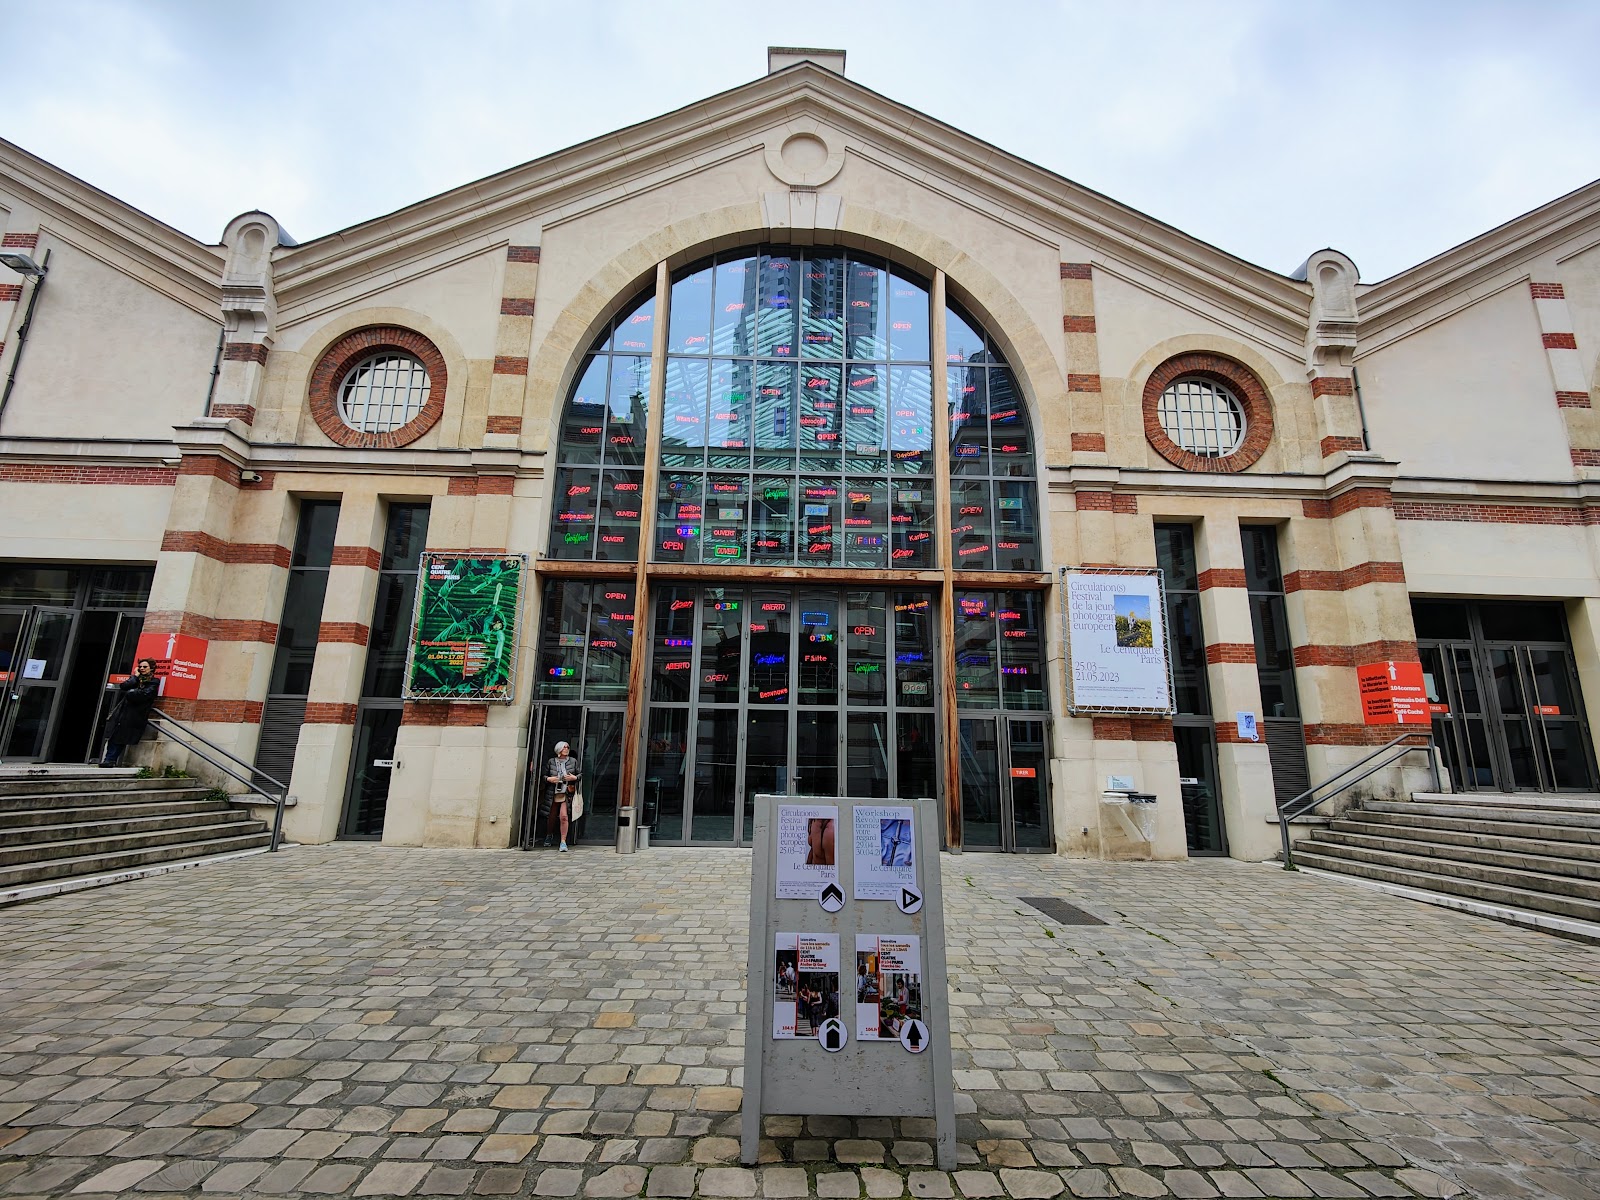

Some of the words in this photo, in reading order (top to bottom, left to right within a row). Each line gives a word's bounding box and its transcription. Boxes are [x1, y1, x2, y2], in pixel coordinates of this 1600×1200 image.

[686, 336, 704, 344] Open
[807, 378, 828, 388] Open
[568, 486, 590, 495] Open
[676, 526, 700, 535] OPEN
[662, 541, 684, 549] OPEN
[809, 543, 831, 553] Open
[892, 548, 914, 558] Open
[1071, 582, 1126, 593] Circulation(s)
[1071, 592, 1102, 601] Festival
[1073, 602, 1083, 610] de
[1085, 602, 1092, 610] la
[854, 626, 876, 635] OPEN
[1100, 644, 1111, 654] Le
[1113, 645, 1161, 657] Centquatre
[1140, 655, 1162, 664] Paris
[1075, 662, 1097, 671] 25.03
[1076, 671, 1120, 682] 21.05.2023
[856, 810, 900, 818] Workshop
